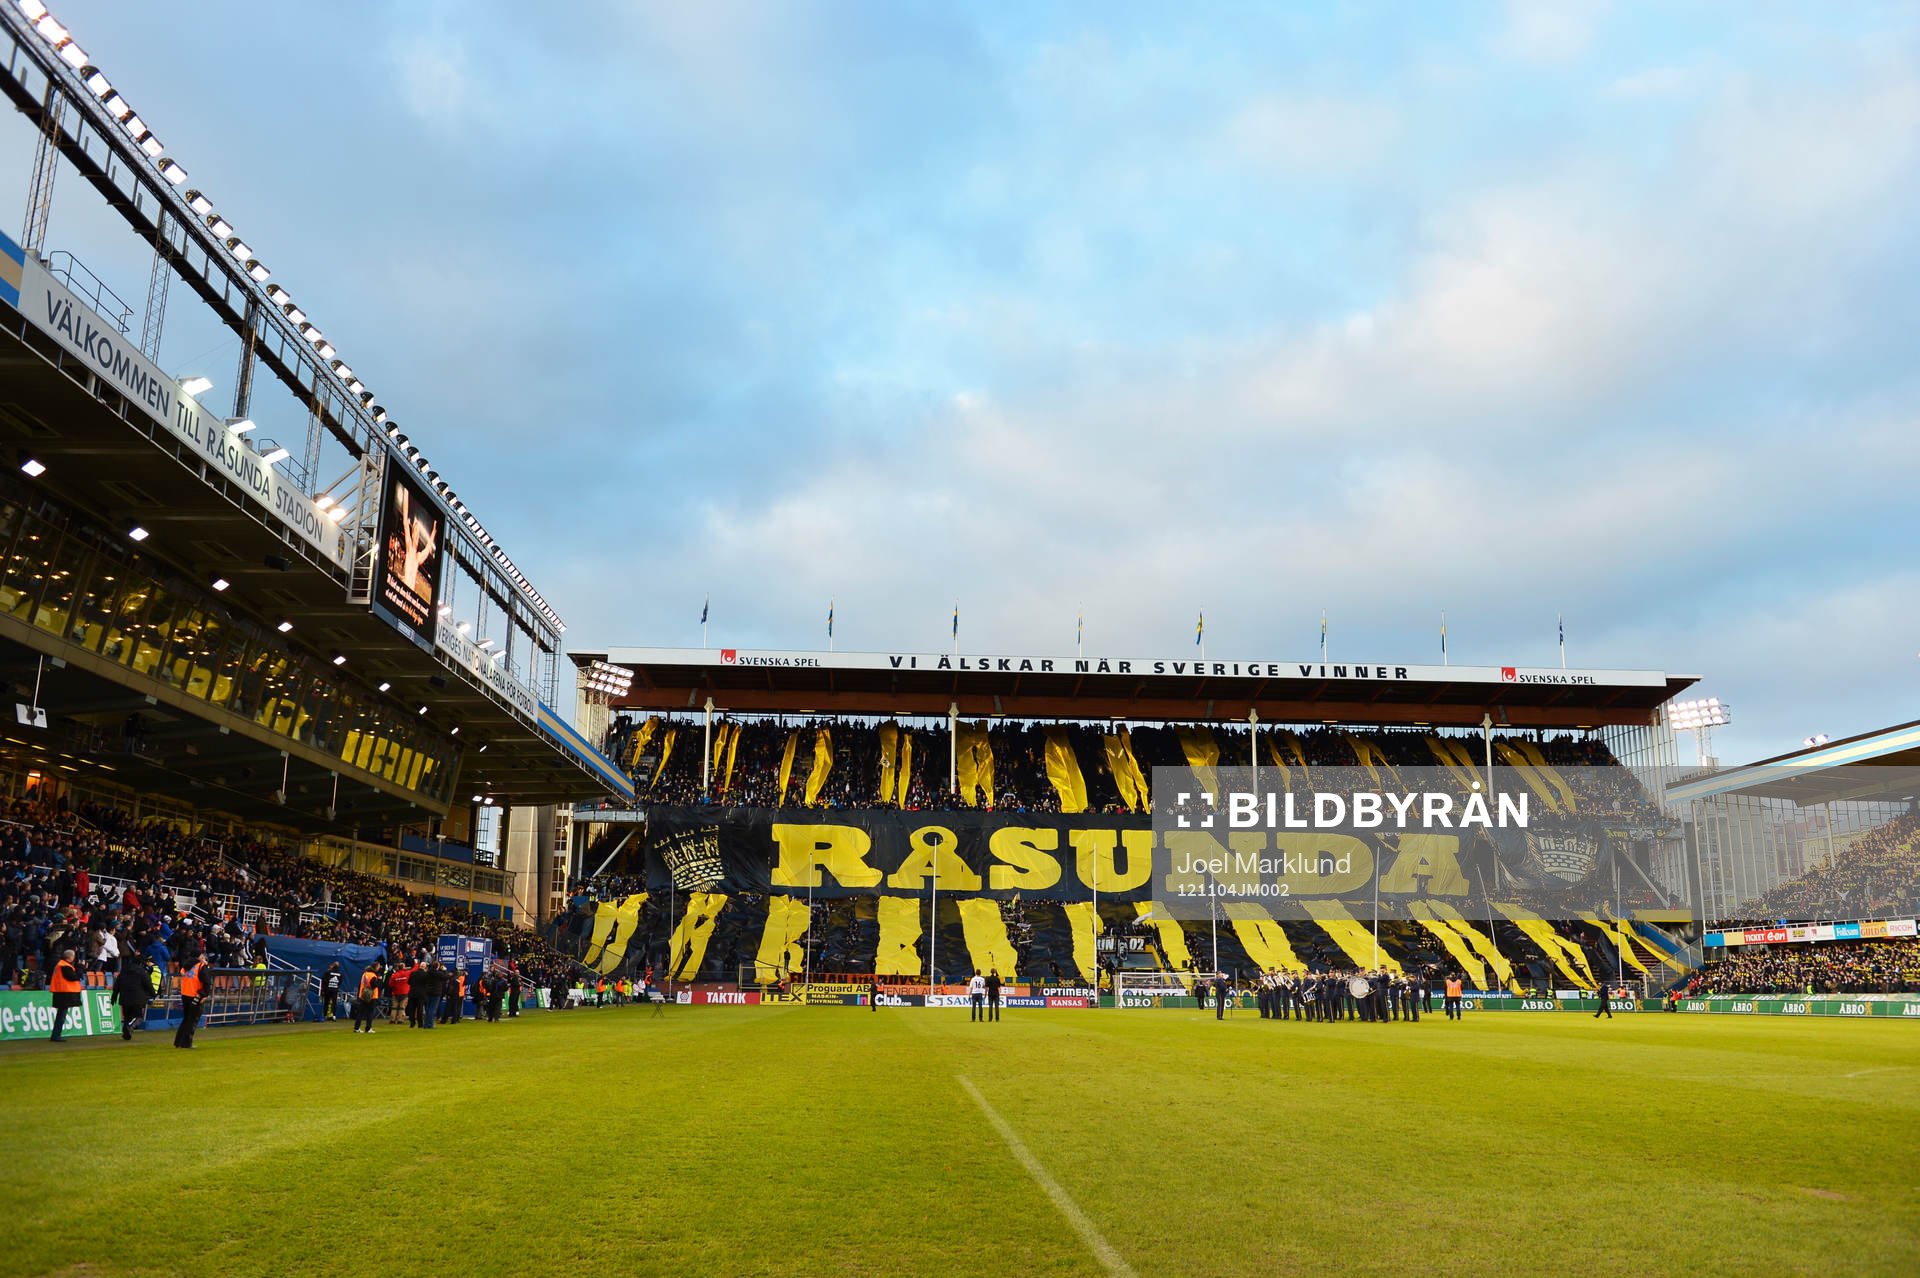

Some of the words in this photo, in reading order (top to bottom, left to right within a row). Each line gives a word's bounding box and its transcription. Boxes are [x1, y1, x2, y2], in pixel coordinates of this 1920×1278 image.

[46, 288, 171, 418] VÄLKOMMEN
[176, 400, 201, 445] TILL
[206, 431, 270, 502] RÅSUNDA
[275, 486, 322, 543] STADION
[437, 624, 461, 655] VERIGES
[739, 656, 790, 667] SVENSKA
[794, 658, 821, 667] SPEL
[889, 656, 917, 668] VI
[937, 654, 1054, 672] ÄLSKAR
[1075, 658, 1132, 673] NÄR
[1153, 661, 1279, 676] SVERIGE
[1299, 665, 1409, 679] VINNER
[1519, 674, 1567, 684] SVENSKA
[1571, 676, 1596, 685] SPEL
[771, 824, 1470, 896] RÅSUNDA
[1889, 924, 1913, 933] RICOH
[807, 985, 852, 994] Proguard
[1043, 988, 1095, 996] OPTIMERA
[706, 992, 746, 1004] TAKTIK
[1008, 998, 1044, 1006] FRISTADS
[1521, 999, 1553, 1010] ÅBRO
[1609, 1001, 1633, 1010] BRO
[1686, 1000, 1705, 1011] ÅBRO
[1732, 1001, 1752, 1012] ÅBRO
[1782, 1002, 1805, 1013] ÅBRO
[1839, 1003, 1865, 1014] ÅBRO
